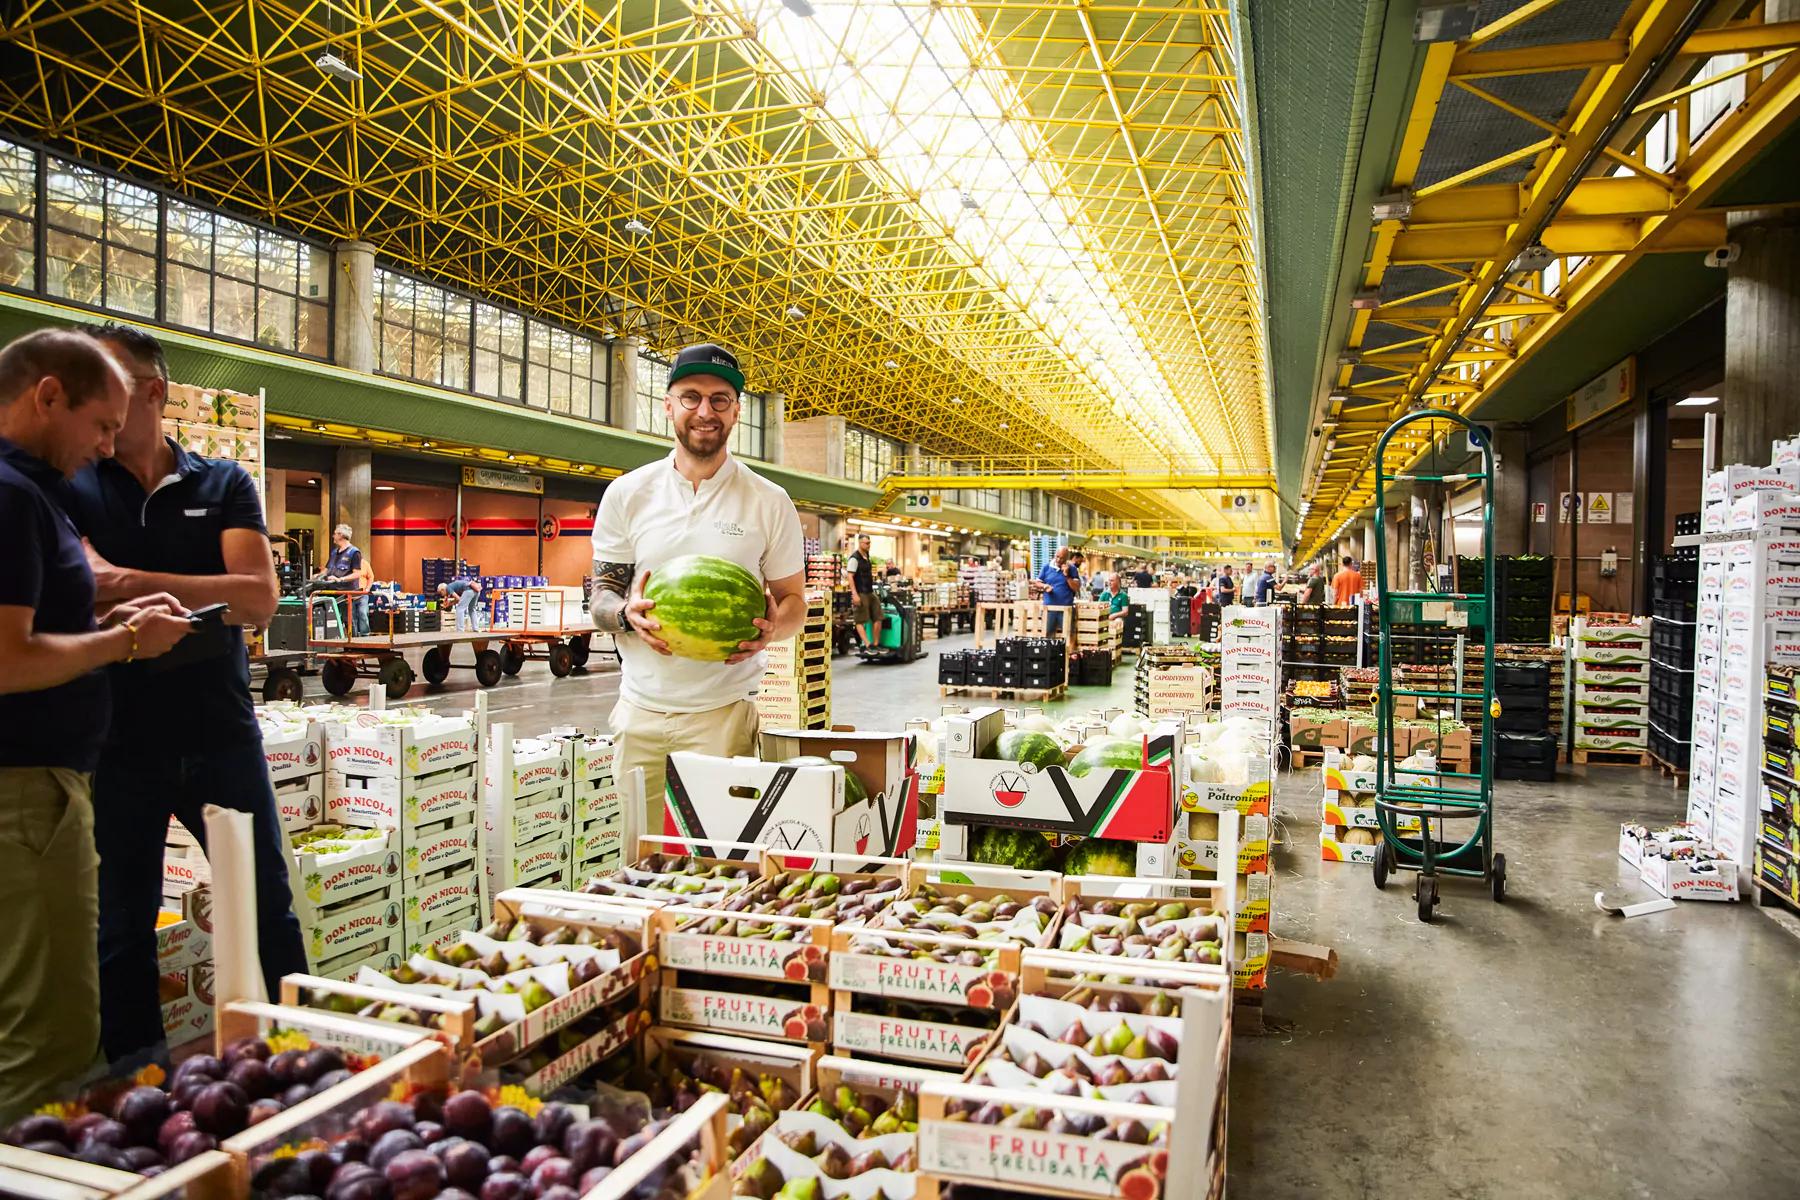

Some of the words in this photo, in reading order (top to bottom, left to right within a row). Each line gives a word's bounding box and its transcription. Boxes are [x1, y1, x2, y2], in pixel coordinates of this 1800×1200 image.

[464, 468, 475, 483] 53
[1734, 480, 1756, 491] DON
[1758, 479, 1794, 491] NICOLA
[1764, 507, 1787, 518] DON
[1768, 542, 1787, 551] ON
[1767, 577, 1786, 586] ON
[1766, 610, 1786, 620] ON
[1243, 619, 1270, 628] NICOLA
[1225, 647, 1242, 655] DON
[1243, 647, 1271, 656] NICOLA
[1224, 674, 1240, 683] DON
[1242, 674, 1269, 684] NICOLA
[1224, 702, 1240, 710] DON
[1242, 702, 1269, 711] NICOLA
[329, 747, 351, 760] DON
[354, 747, 393, 766] NICOLA
[420, 745, 438, 762] DON
[439, 741, 468, 751] NICOLA
[588, 757, 603, 771] DON
[604, 754, 614, 762] NIC
[519, 772, 533, 785] DON
[534, 767, 557, 776] NICOLA
[919, 774, 945, 782] tronie
[420, 795, 438, 812] DON
[439, 790, 468, 801] NICOLA
[588, 797, 603, 810] DON
[1208, 792, 1267, 803] Poltronieri
[282, 806, 301, 817] OLA
[329, 797, 351, 810] DON
[354, 797, 393, 817] NICOLA
[534, 811, 557, 820] NICOLA
[420, 846, 439, 862] DON
[440, 838, 467, 849] NICOLA
[585, 836, 600, 849] DON
[520, 859, 534, 872] DON
[535, 852, 557, 861] NICOLA
[323, 872, 345, 890] DON
[348, 862, 381, 878] NICOLA
[333, 881, 348, 890] Gusto
[1672, 880, 1694, 890] DON
[420, 895, 439, 911] DON
[440, 885, 468, 898] NICOLA
[1235, 912, 1267, 921] onieri
[324, 926, 346, 945] DON
[348, 916, 382, 930] NICOLA
[334, 937, 349, 945] Gusto
[703, 940, 780, 958] FRUTTA
[703, 952, 780, 969] PRELIBATA
[879, 962, 961, 982] FRUTTA
[1234, 968, 1263, 977] onieri
[878, 976, 961, 995] PRELIBATA
[543, 984, 597, 1018] FRUTTA
[703, 996, 780, 1014] FRUTTA
[703, 1008, 780, 1026] PRELIBATA
[879, 1021, 961, 1043] FRUTTA
[879, 1035, 961, 1054] PRELIBATA
[879, 1077, 918, 1093] FRU
[989, 1134, 1110, 1167] FRUTTA
[989, 1153, 1110, 1182] PRELIBATA
